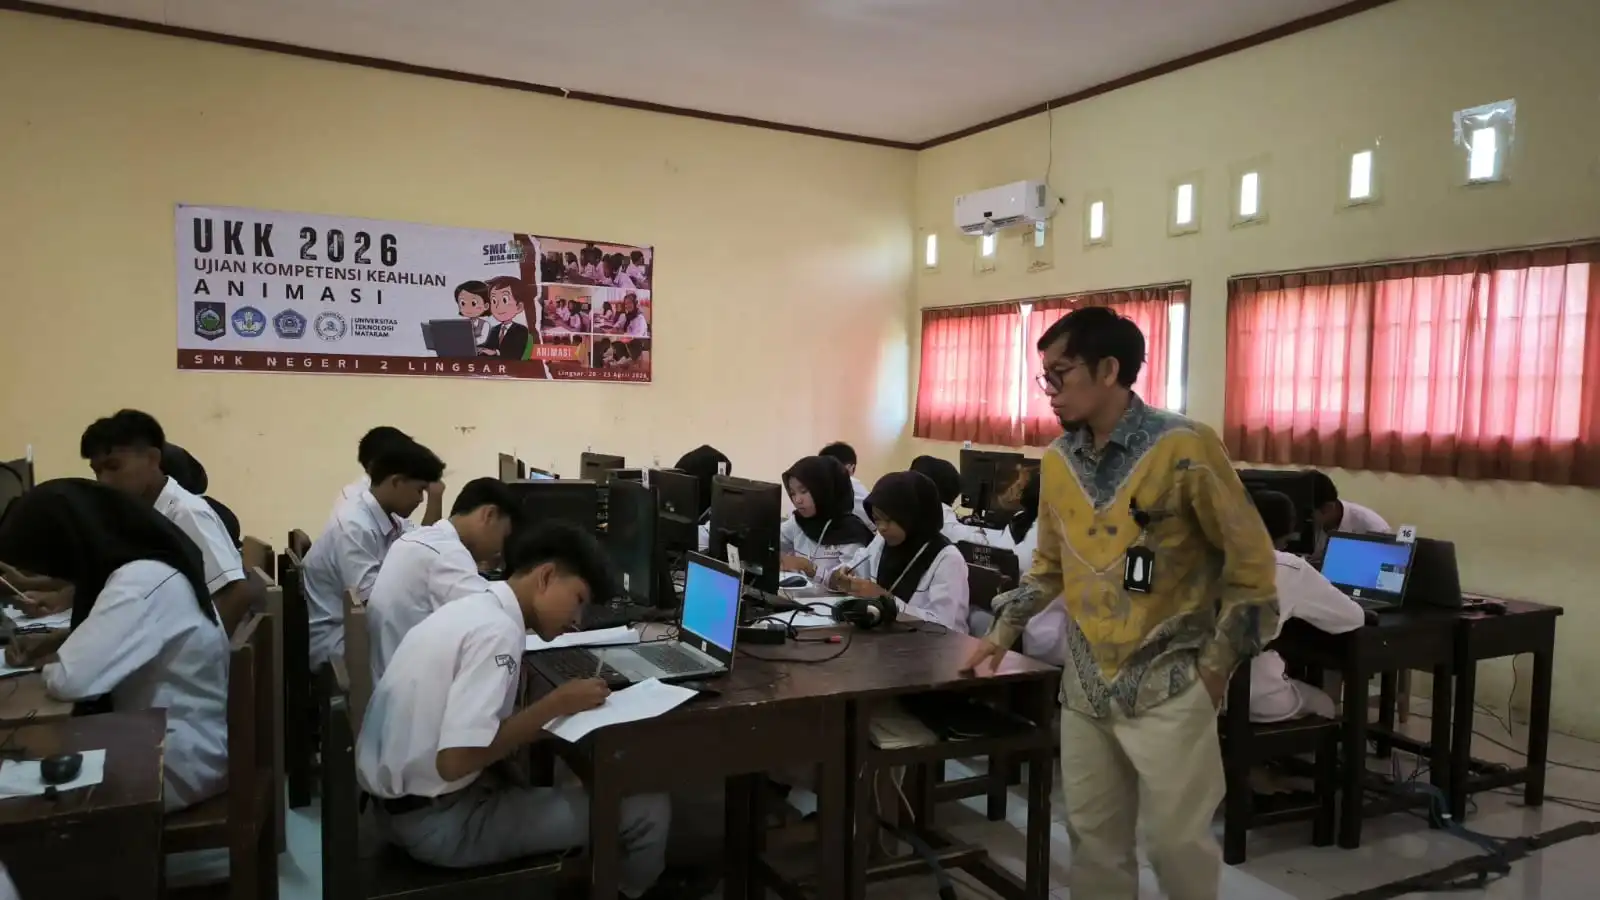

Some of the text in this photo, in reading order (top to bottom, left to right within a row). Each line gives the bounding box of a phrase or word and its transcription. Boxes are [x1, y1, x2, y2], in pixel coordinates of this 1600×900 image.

[193, 217, 398, 266] UKK 2026
[482, 243, 506, 255] SMK
[194, 257, 446, 287] UJIAN KOMPETENSI KEAHLIAN
[193, 279, 382, 305] ANIMASI
[354, 317, 398, 325] UNIVERSITAS
[536, 347, 571, 357] ANIMASI
[194, 354, 507, 373] SMK NEGERI 2 LINGSAR
[613, 371, 630, 379] April
[1402, 530, 1413, 538] 16
